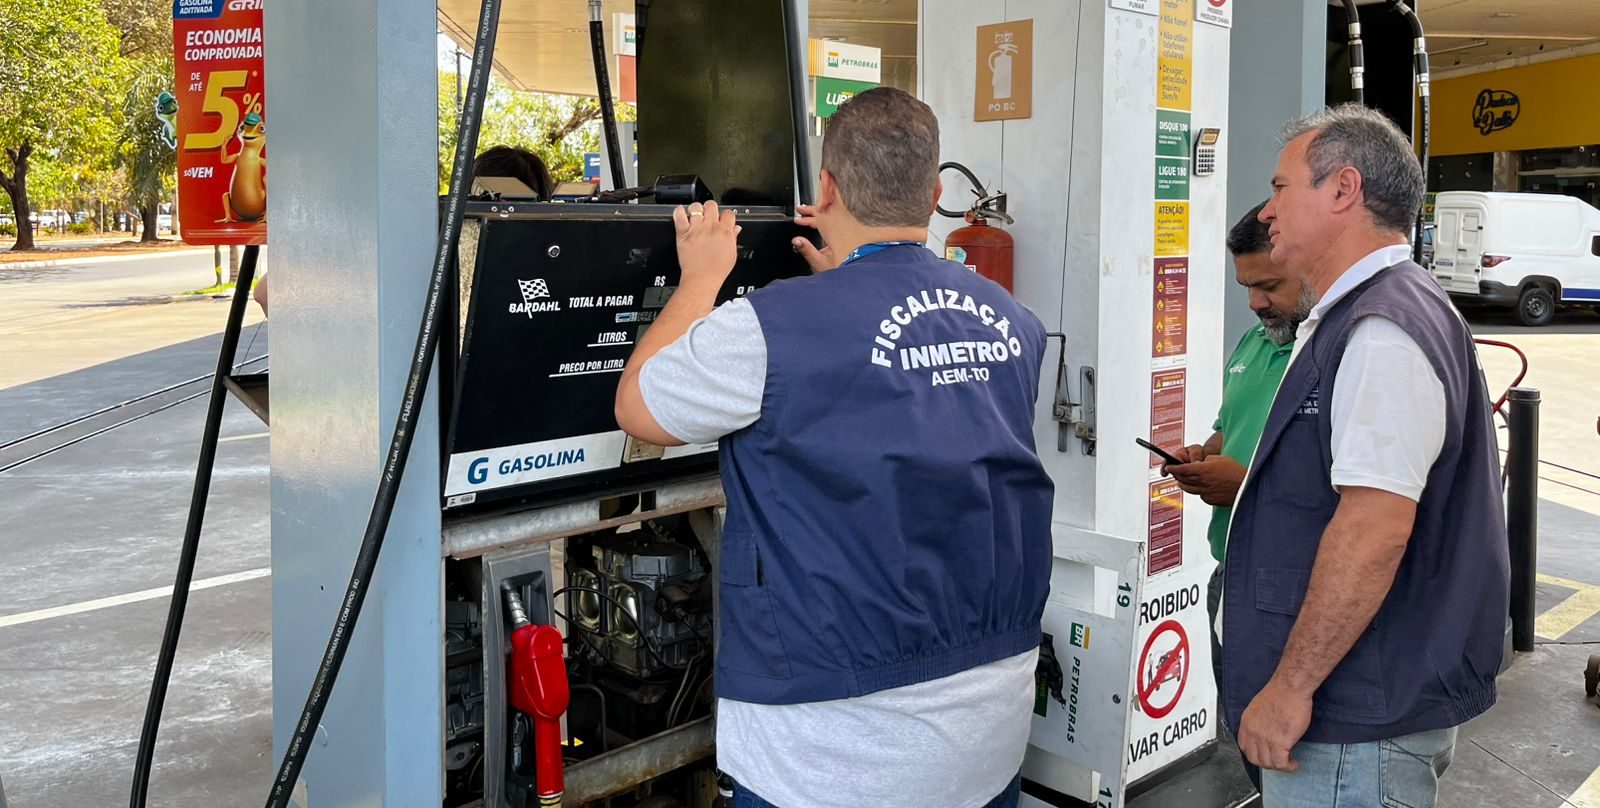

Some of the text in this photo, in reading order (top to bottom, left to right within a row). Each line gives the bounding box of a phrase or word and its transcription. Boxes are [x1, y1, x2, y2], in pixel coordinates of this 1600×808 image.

[179, 6, 213, 15] ADITIVADA
[228, 0, 263, 11] GRI
[1128, 2, 1145, 11] FUMAR
[186, 28, 262, 46] ECONOMIA
[185, 46, 263, 61] COMPROVADA
[841, 58, 878, 69] PETROBRAS
[191, 73, 201, 81] DE
[1162, 74, 1188, 86] velocidade
[189, 82, 202, 92] ATÉ
[1159, 120, 1179, 132] DISQUE
[1158, 165, 1176, 176] LIGUE
[1158, 203, 1185, 216] ATENÇÃO!
[653, 276, 666, 287] R$
[568, 295, 634, 308] TOTAL A PAGAR
[508, 302, 561, 317] BARDAHL
[871, 288, 1021, 368] FISCALIZAÇÃO
[597, 331, 627, 343] LITROS
[899, 341, 1008, 370] INMETRO
[587, 361, 601, 372] POR
[603, 359, 624, 370] LITRO
[931, 367, 989, 386] AEM-TO
[467, 448, 586, 485] G GASOLINA
[1117, 582, 1132, 608] 19
[1139, 583, 1199, 626] ROIBIDO
[1066, 622, 1084, 744] BR PETROBRAS
[1163, 708, 1207, 747] CARRO
